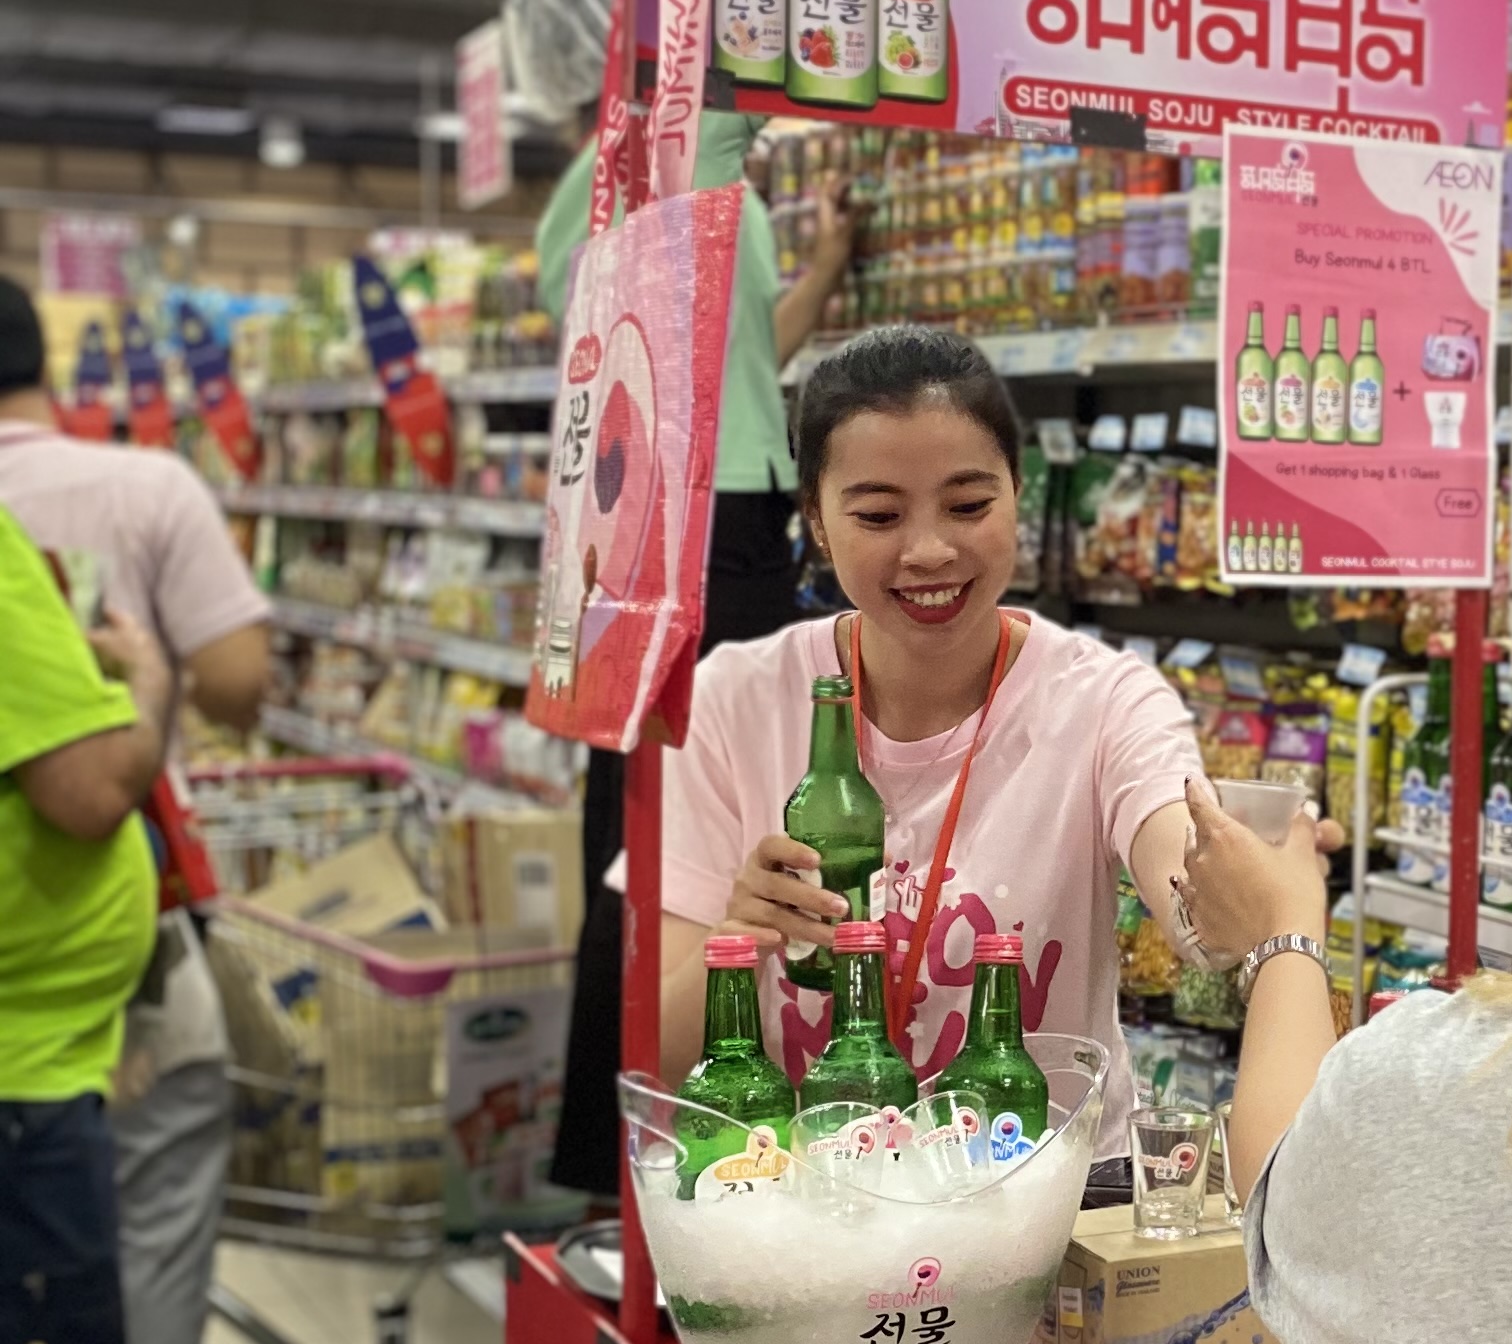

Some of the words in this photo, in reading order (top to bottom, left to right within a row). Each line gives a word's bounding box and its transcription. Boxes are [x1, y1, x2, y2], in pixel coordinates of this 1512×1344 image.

[1149, 97, 1213, 127] SOJU
[1297, 222, 1350, 240] SPECIAL
[1355, 227, 1434, 245] PROMOTION
[1295, 249, 1320, 268] Buy
[1325, 252, 1383, 270] Seonmul
[1387, 259, 1396, 270] 4
[1400, 258, 1432, 274] BTL
[1276, 462, 1296, 476] Get
[1308, 464, 1359, 481] shopping
[1363, 467, 1384, 481] bag
[1388, 466, 1397, 478] &
[1410, 466, 1441, 480] Glass
[1443, 494, 1473, 510] Free
[1321, 556, 1368, 568] SEONMUL
[1117, 1265, 1161, 1281] UNION
